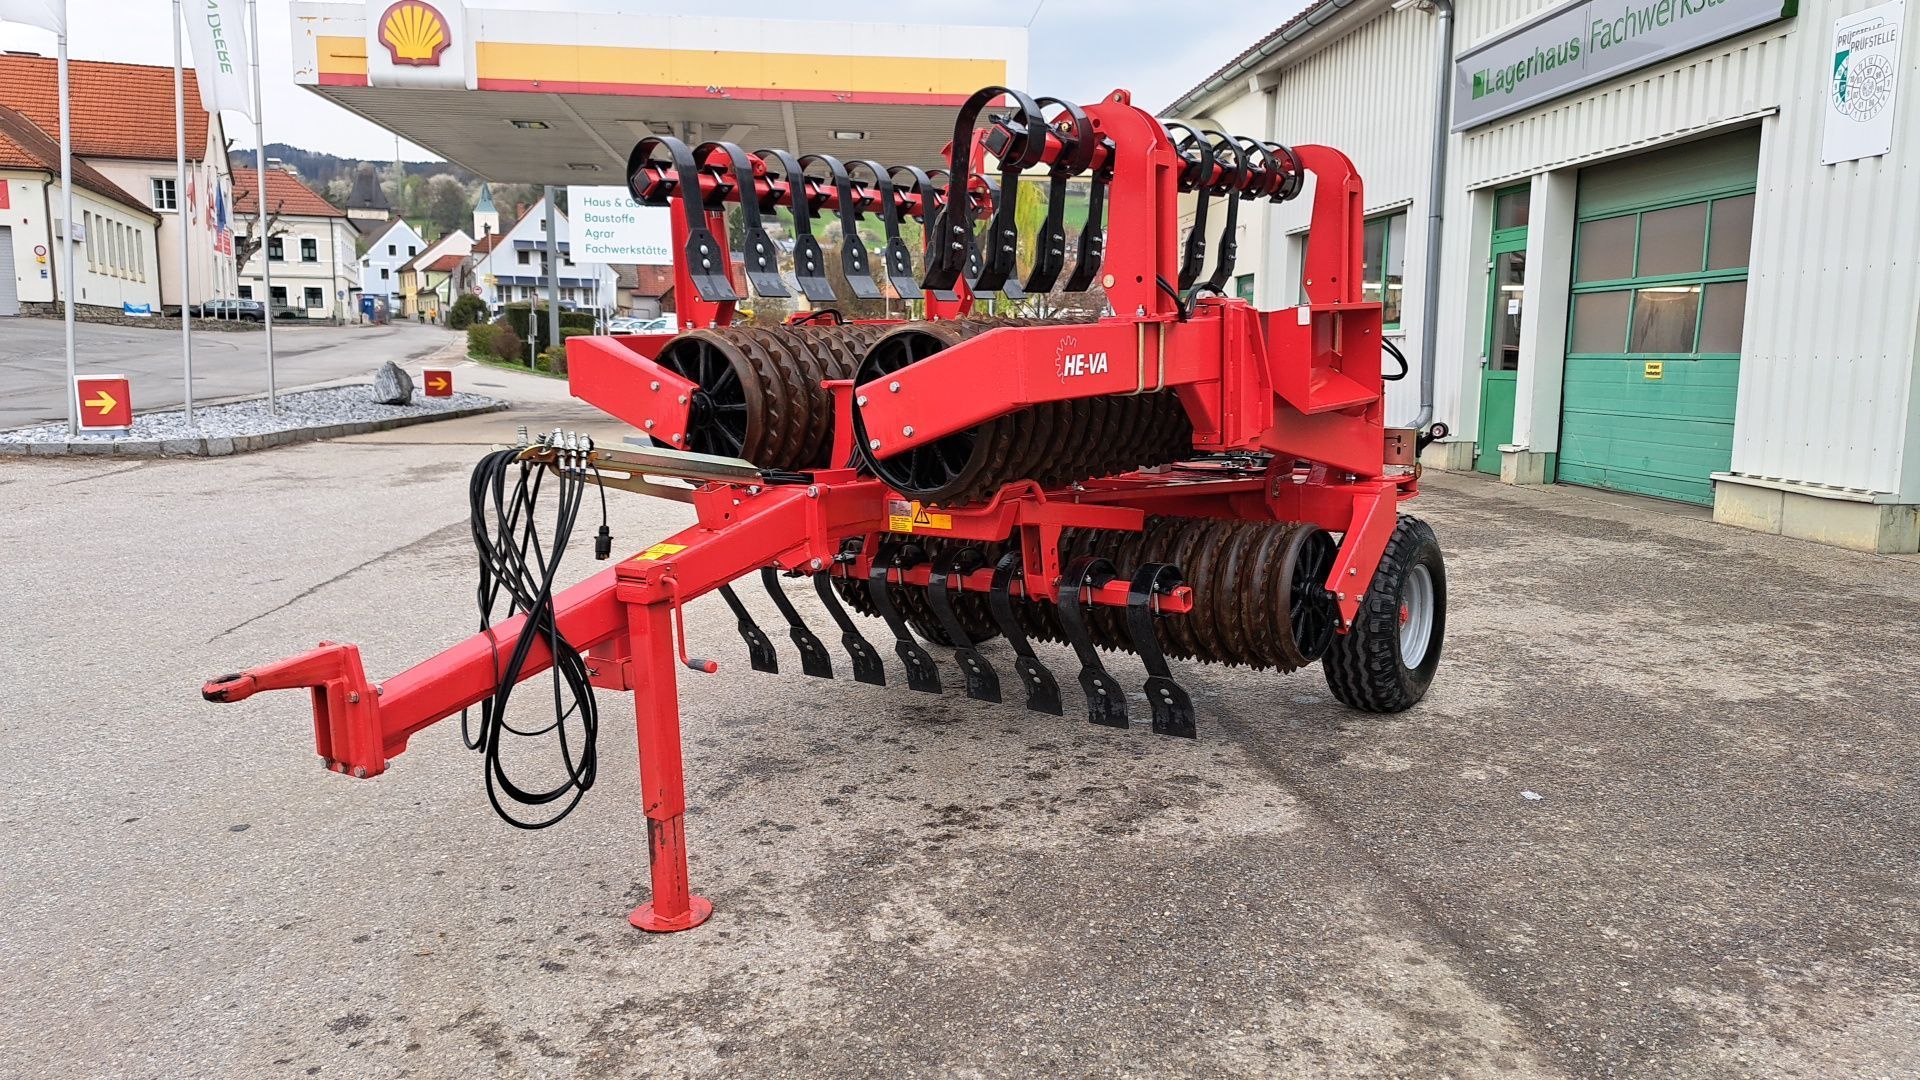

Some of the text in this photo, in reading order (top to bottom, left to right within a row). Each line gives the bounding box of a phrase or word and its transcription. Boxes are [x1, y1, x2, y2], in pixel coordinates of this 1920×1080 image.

[207, 13, 233, 75] DEERE
[1850, 29, 1896, 53] PRÜFSTELLE
[1485, 37, 1580, 95] Lagerhaus
[583, 197, 612, 207] Haus
[614, 198, 622, 208] &
[584, 213, 635, 224] Baustoffe
[584, 228, 615, 240] Agrar
[585, 244, 668, 256] Fachwerkstätte
[1063, 352, 1108, 377] HE-VA
